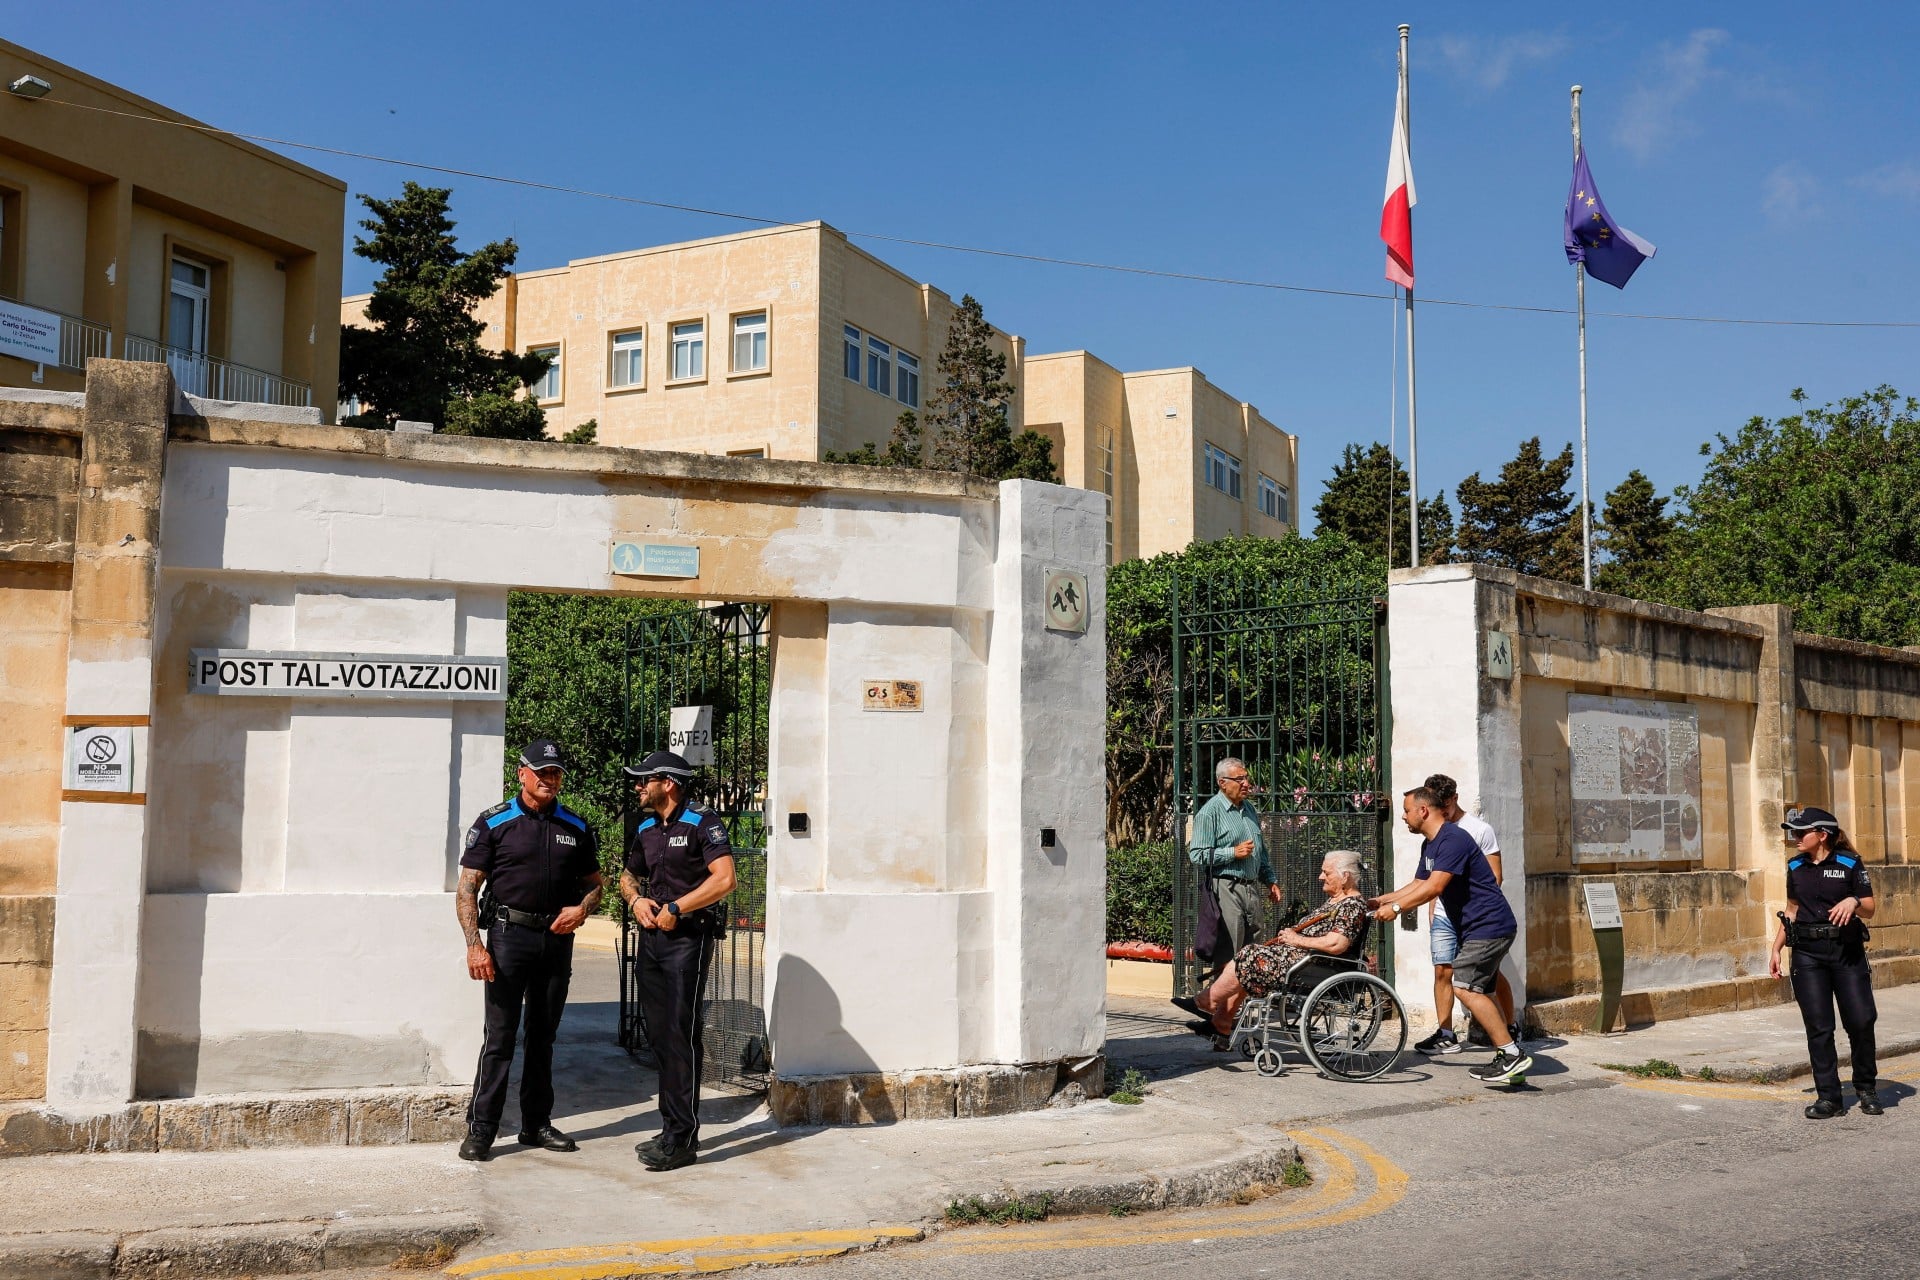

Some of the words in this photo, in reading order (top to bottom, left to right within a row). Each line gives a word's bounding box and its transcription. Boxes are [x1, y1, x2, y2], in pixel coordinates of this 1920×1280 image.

[2, 320, 20, 330] Carlo
[20, 324, 47, 337] Diacono
[650, 548, 692, 557] Pedestrians
[681, 557, 695, 565] this
[200, 660, 273, 686] POST
[281, 662, 498, 691] TAL-VOTAZZJONI
[669, 729, 700, 747] GATE
[701, 729, 709, 746] 2
[555, 834, 577, 848] PULIZIJA
[1823, 869, 1846, 879] PULIZIJA
